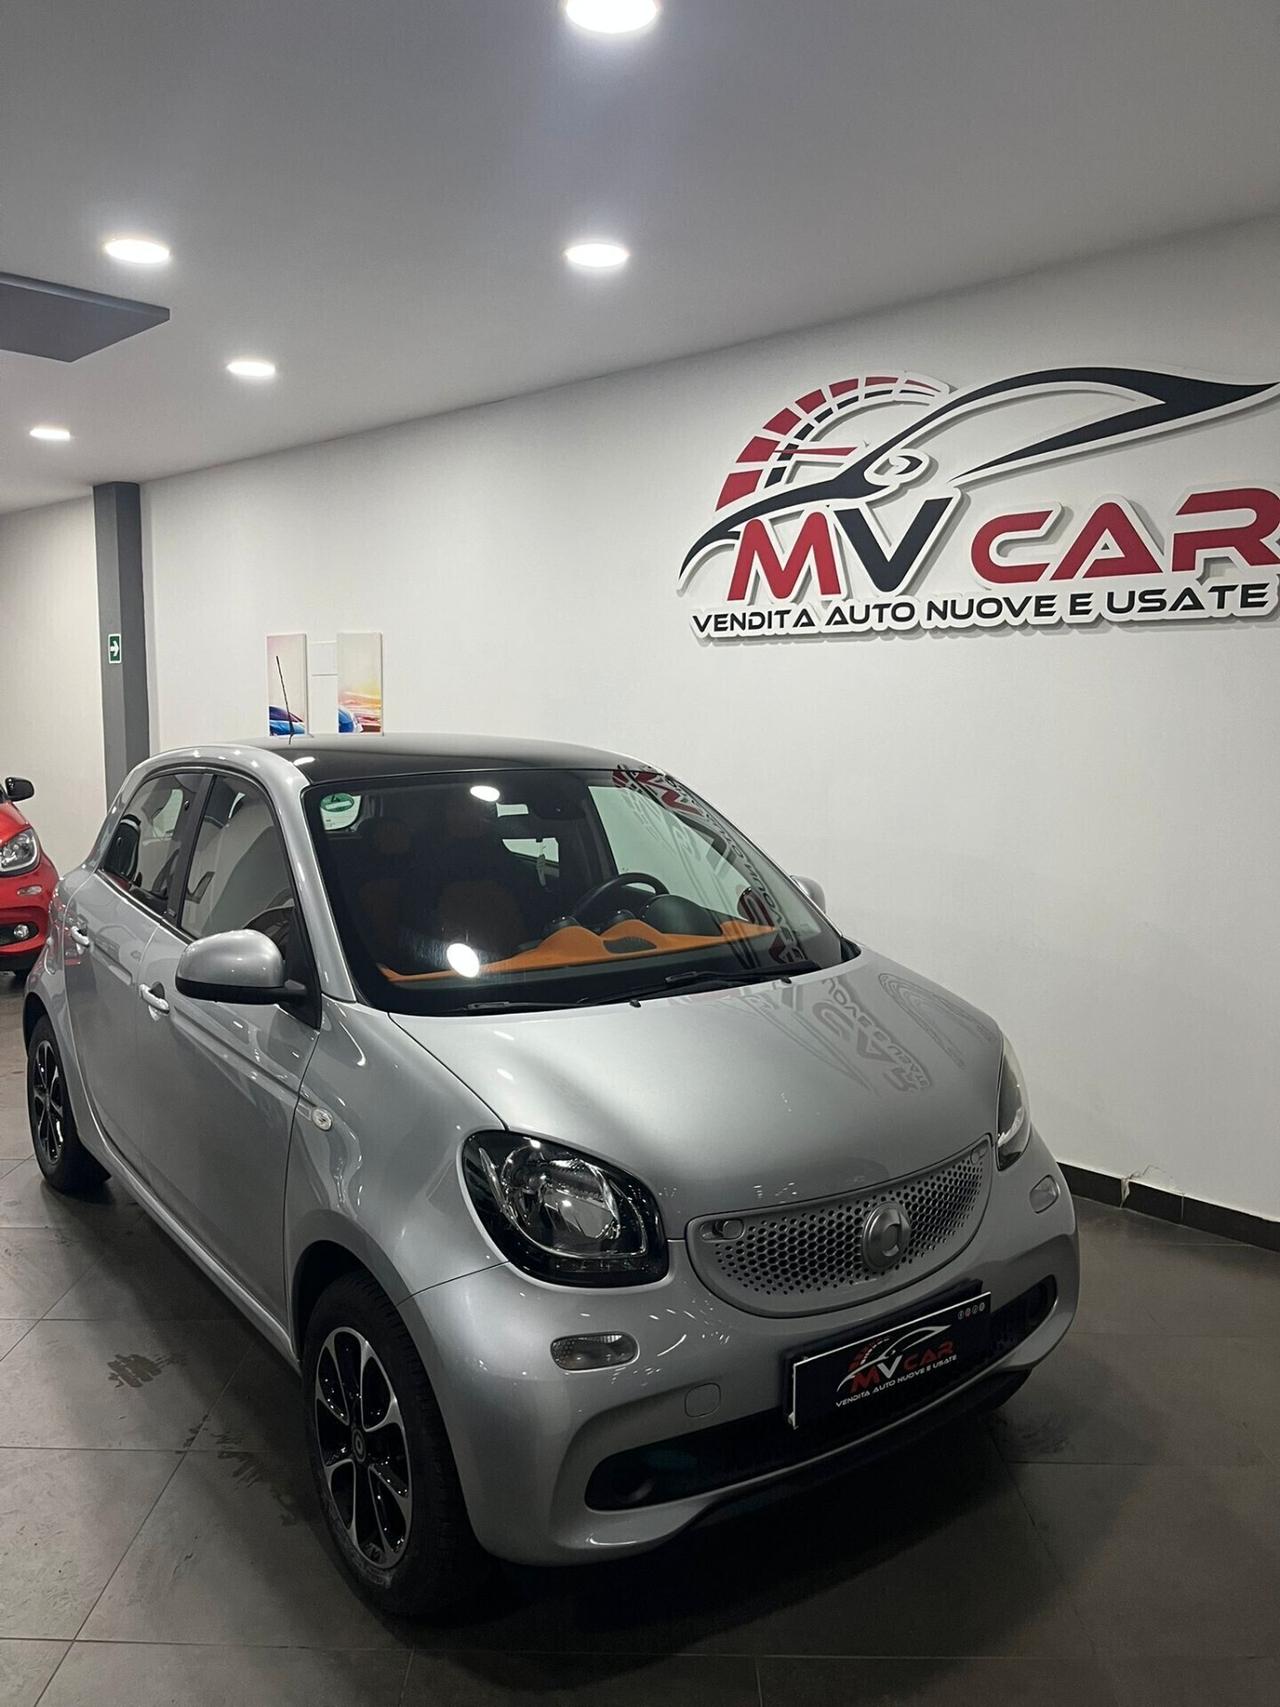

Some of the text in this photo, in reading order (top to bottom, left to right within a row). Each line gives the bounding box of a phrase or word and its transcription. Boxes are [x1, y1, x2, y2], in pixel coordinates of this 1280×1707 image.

[727, 488, 1280, 601] MV CAR
[692, 582, 1270, 632] VENDITA AUTO NUOVE E USATE
[835, 1390, 871, 1408] VENDITA
[872, 1379, 897, 1394] AUTO
[897, 1367, 925, 1384] NUOVE
[932, 1354, 957, 1369] USATE
[903, 1341, 955, 1371] CAR
